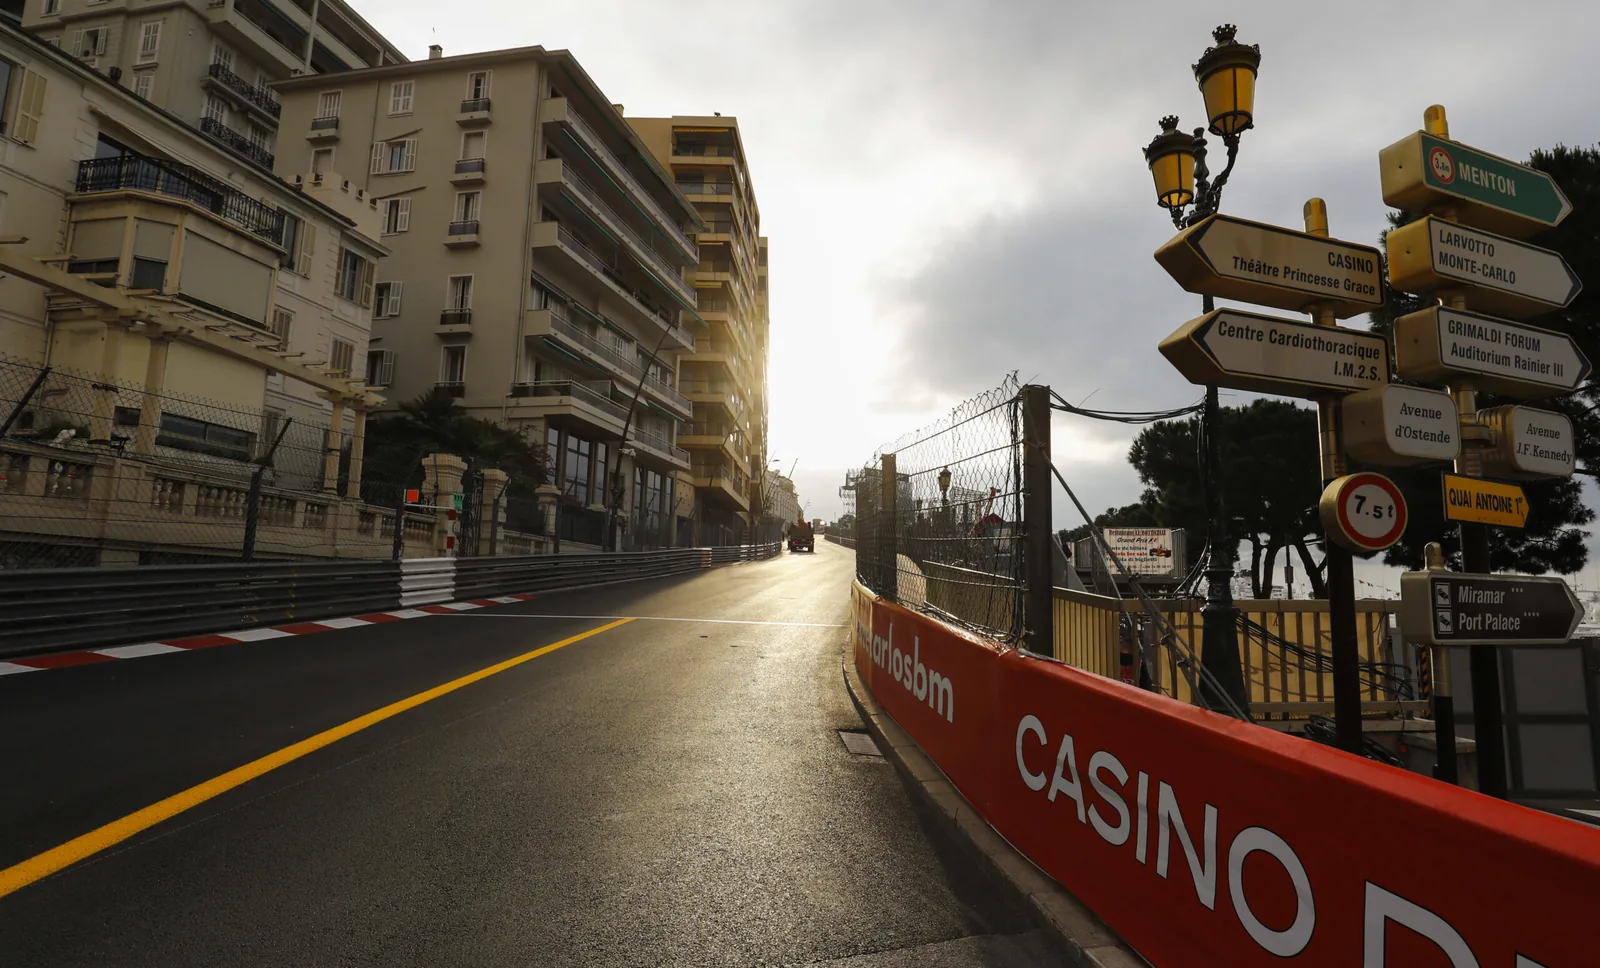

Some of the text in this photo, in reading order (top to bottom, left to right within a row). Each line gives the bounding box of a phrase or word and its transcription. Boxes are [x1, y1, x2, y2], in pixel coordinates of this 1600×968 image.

[1459, 162, 1516, 196] MENTON
[1439, 229, 1495, 257] LARVOTTO
[1232, 256, 1376, 296] Théâtre Princesse Grace
[1328, 252, 1373, 274] CASINO
[1439, 251, 1516, 284] MONTE-CARLO
[1218, 320, 1380, 360] Centre Cardiothoracique
[1448, 319, 1541, 352] GRIMALDI FORUM
[1334, 360, 1381, 381] I.M.2.S.
[1451, 342, 1564, 377] Auditorium Rainier III
[1400, 403, 1442, 420] Avenue
[1395, 425, 1451, 444] d'Ostende
[1526, 423, 1561, 439] Avenue
[1449, 487, 1472, 509] QUAI
[1475, 492, 1513, 514] ANTOINE
[1458, 585, 1506, 604] Miramar
[1459, 612, 1483, 631] Port
[1015, 713, 1317, 958] CASINO
